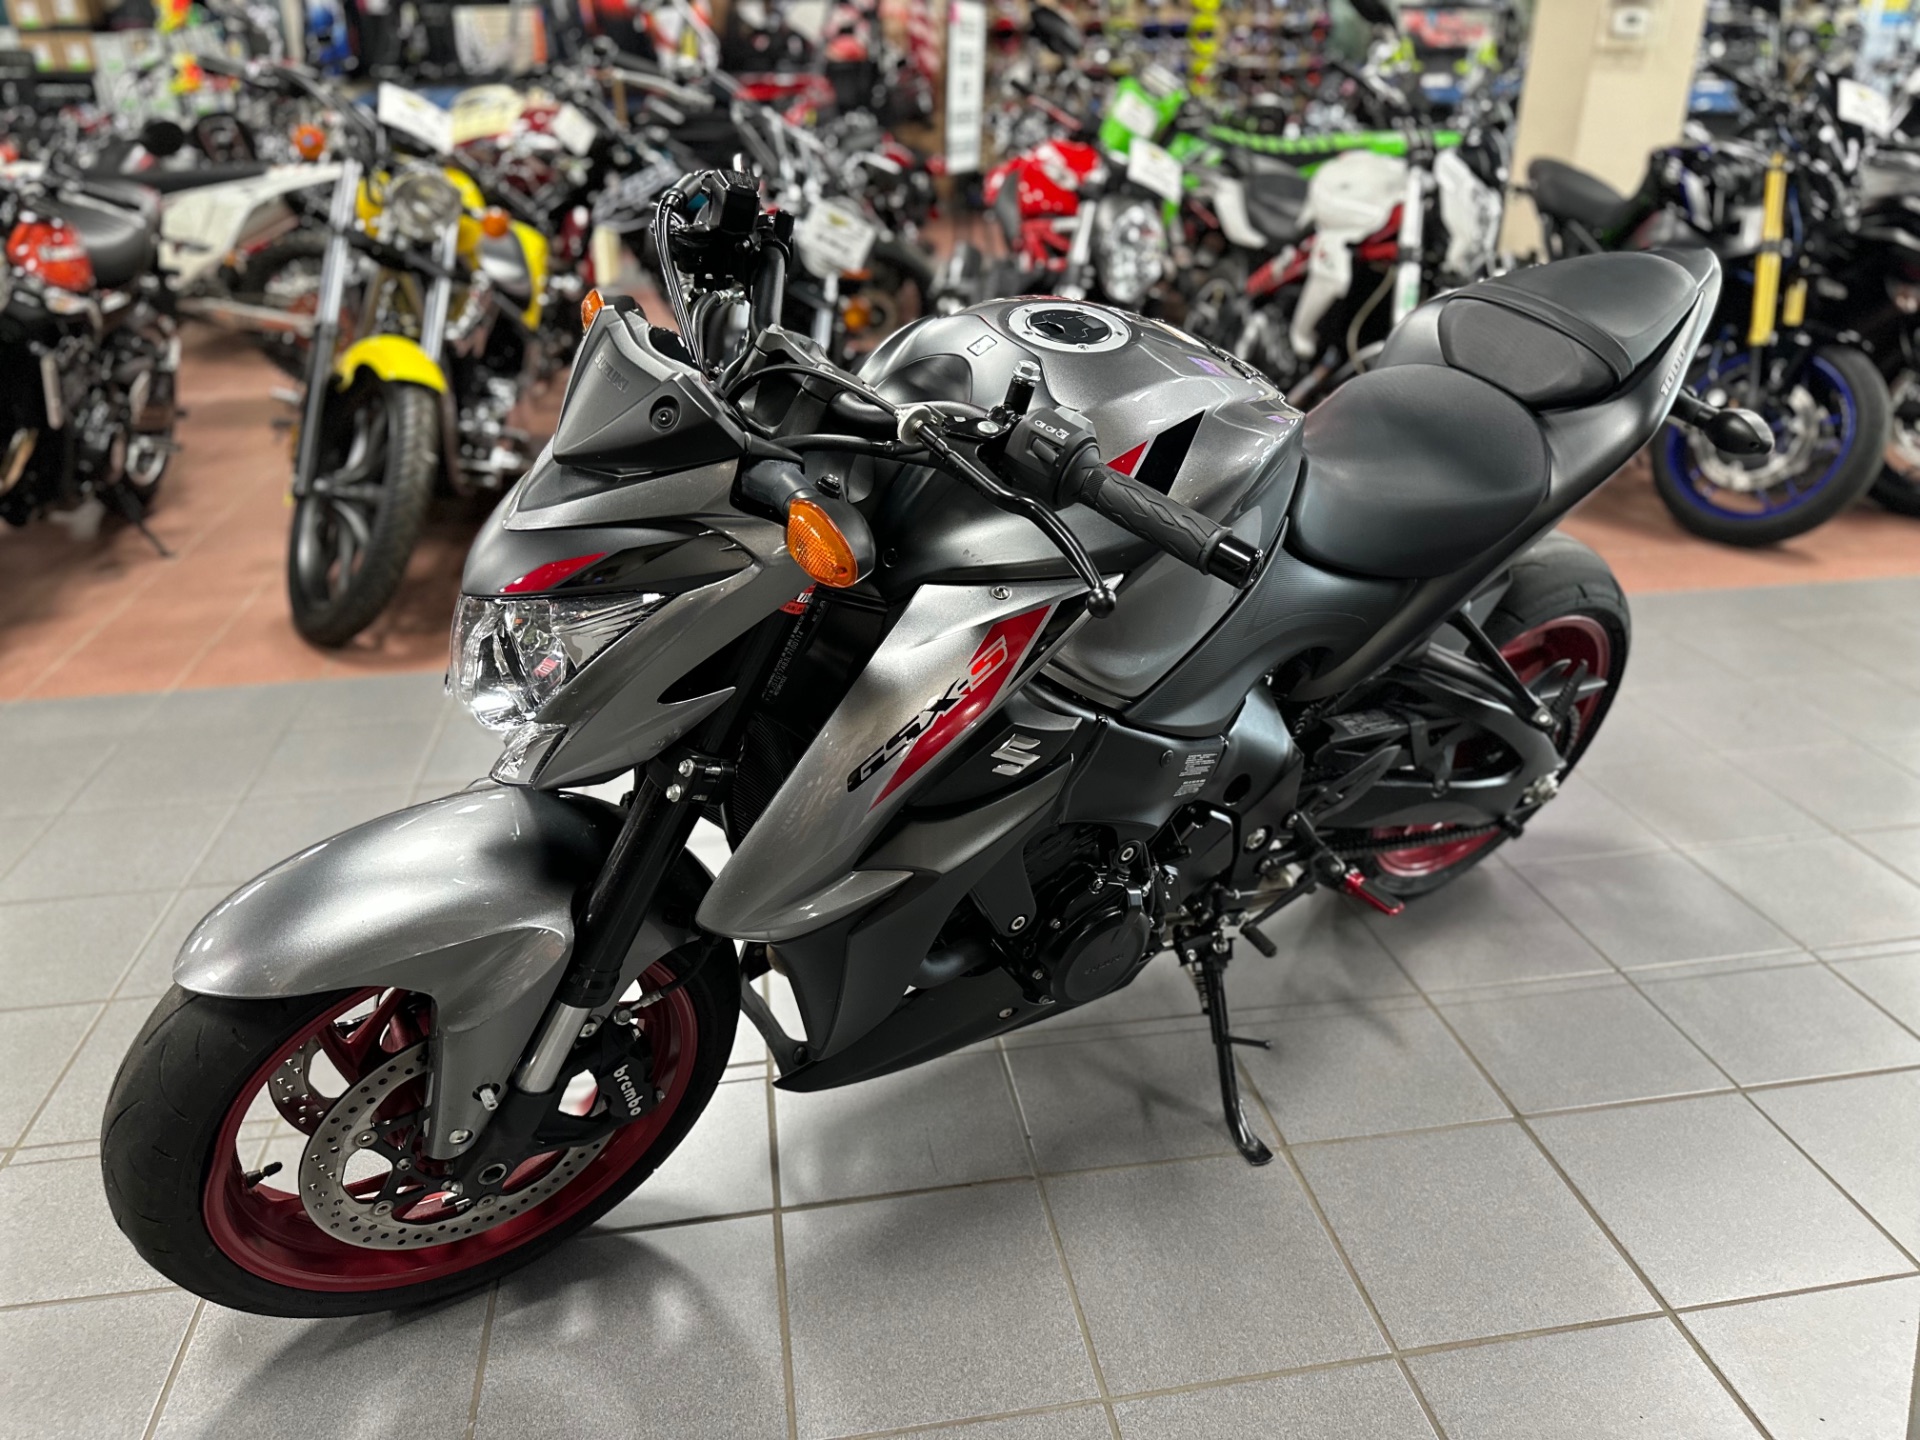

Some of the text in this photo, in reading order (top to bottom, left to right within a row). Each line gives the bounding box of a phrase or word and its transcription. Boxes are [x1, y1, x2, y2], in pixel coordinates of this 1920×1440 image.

[1660, 346, 1686, 396] 1000
[847, 635, 1008, 793] GSX-S
[613, 1064, 644, 1116] brembo
